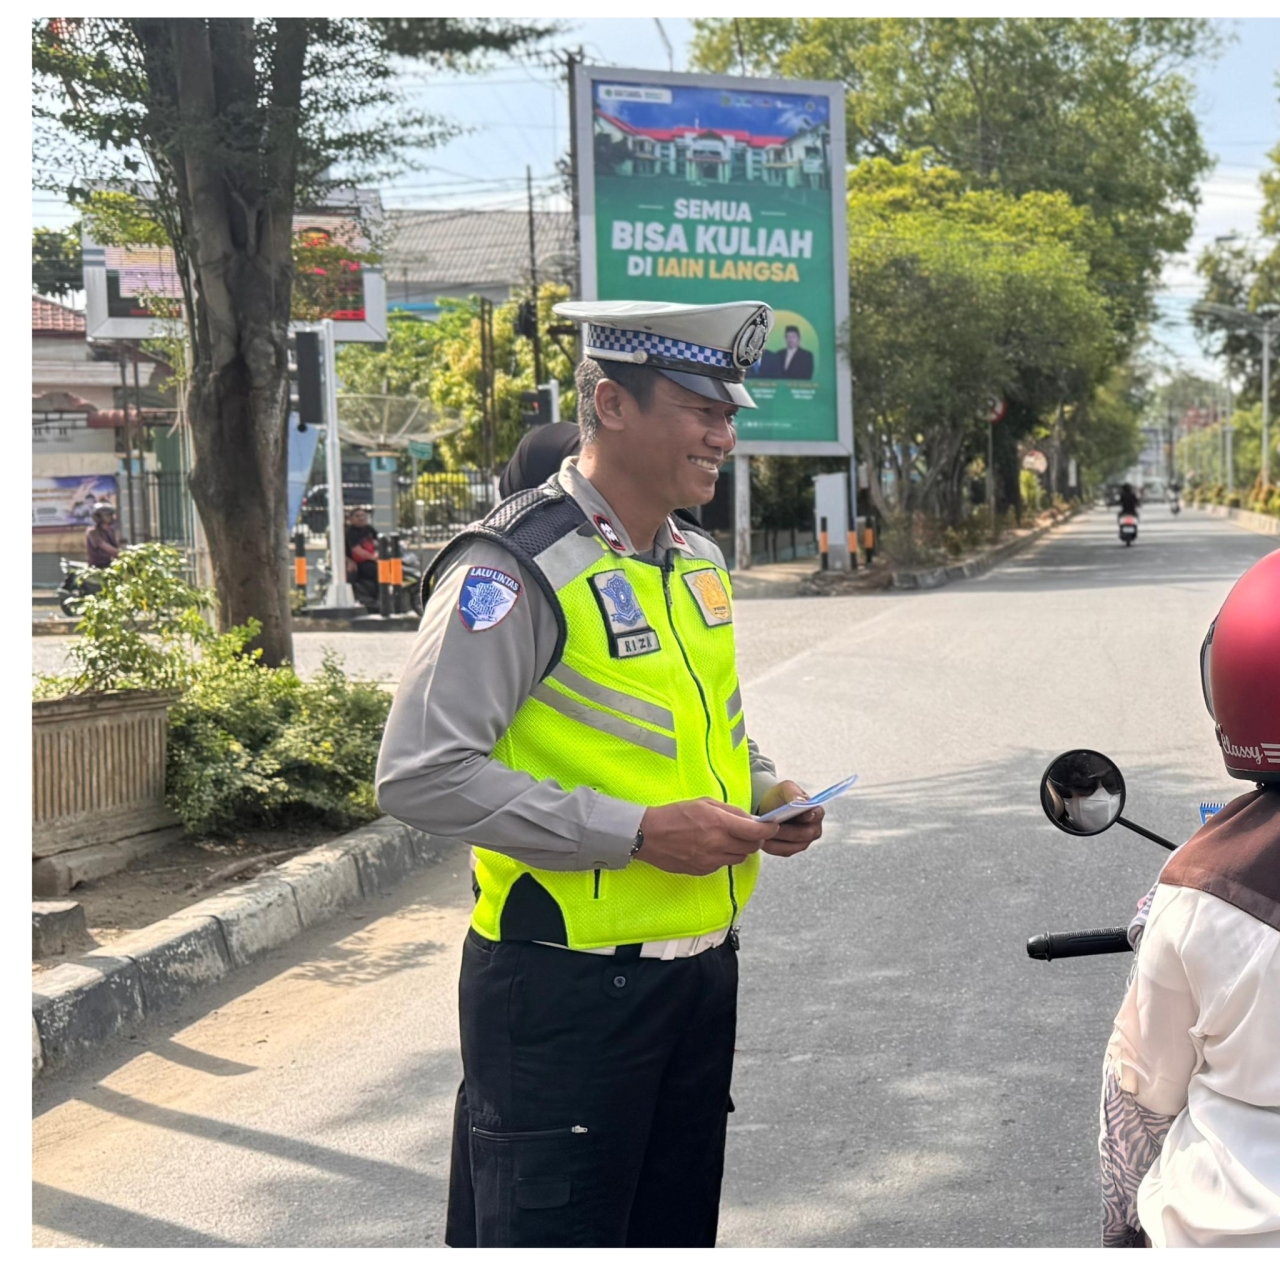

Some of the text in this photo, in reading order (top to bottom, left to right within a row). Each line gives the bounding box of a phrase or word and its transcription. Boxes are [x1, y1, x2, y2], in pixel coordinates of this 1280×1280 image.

[674, 198, 752, 223] SEMUA
[611, 220, 813, 259] BISA KULIAH
[627, 256, 800, 283] DI IAIN LANGSA
[470, 568, 520, 591] LALU LINTAS
[625, 636, 652, 653] RIZA
[1221, 734, 1263, 765] Classy
